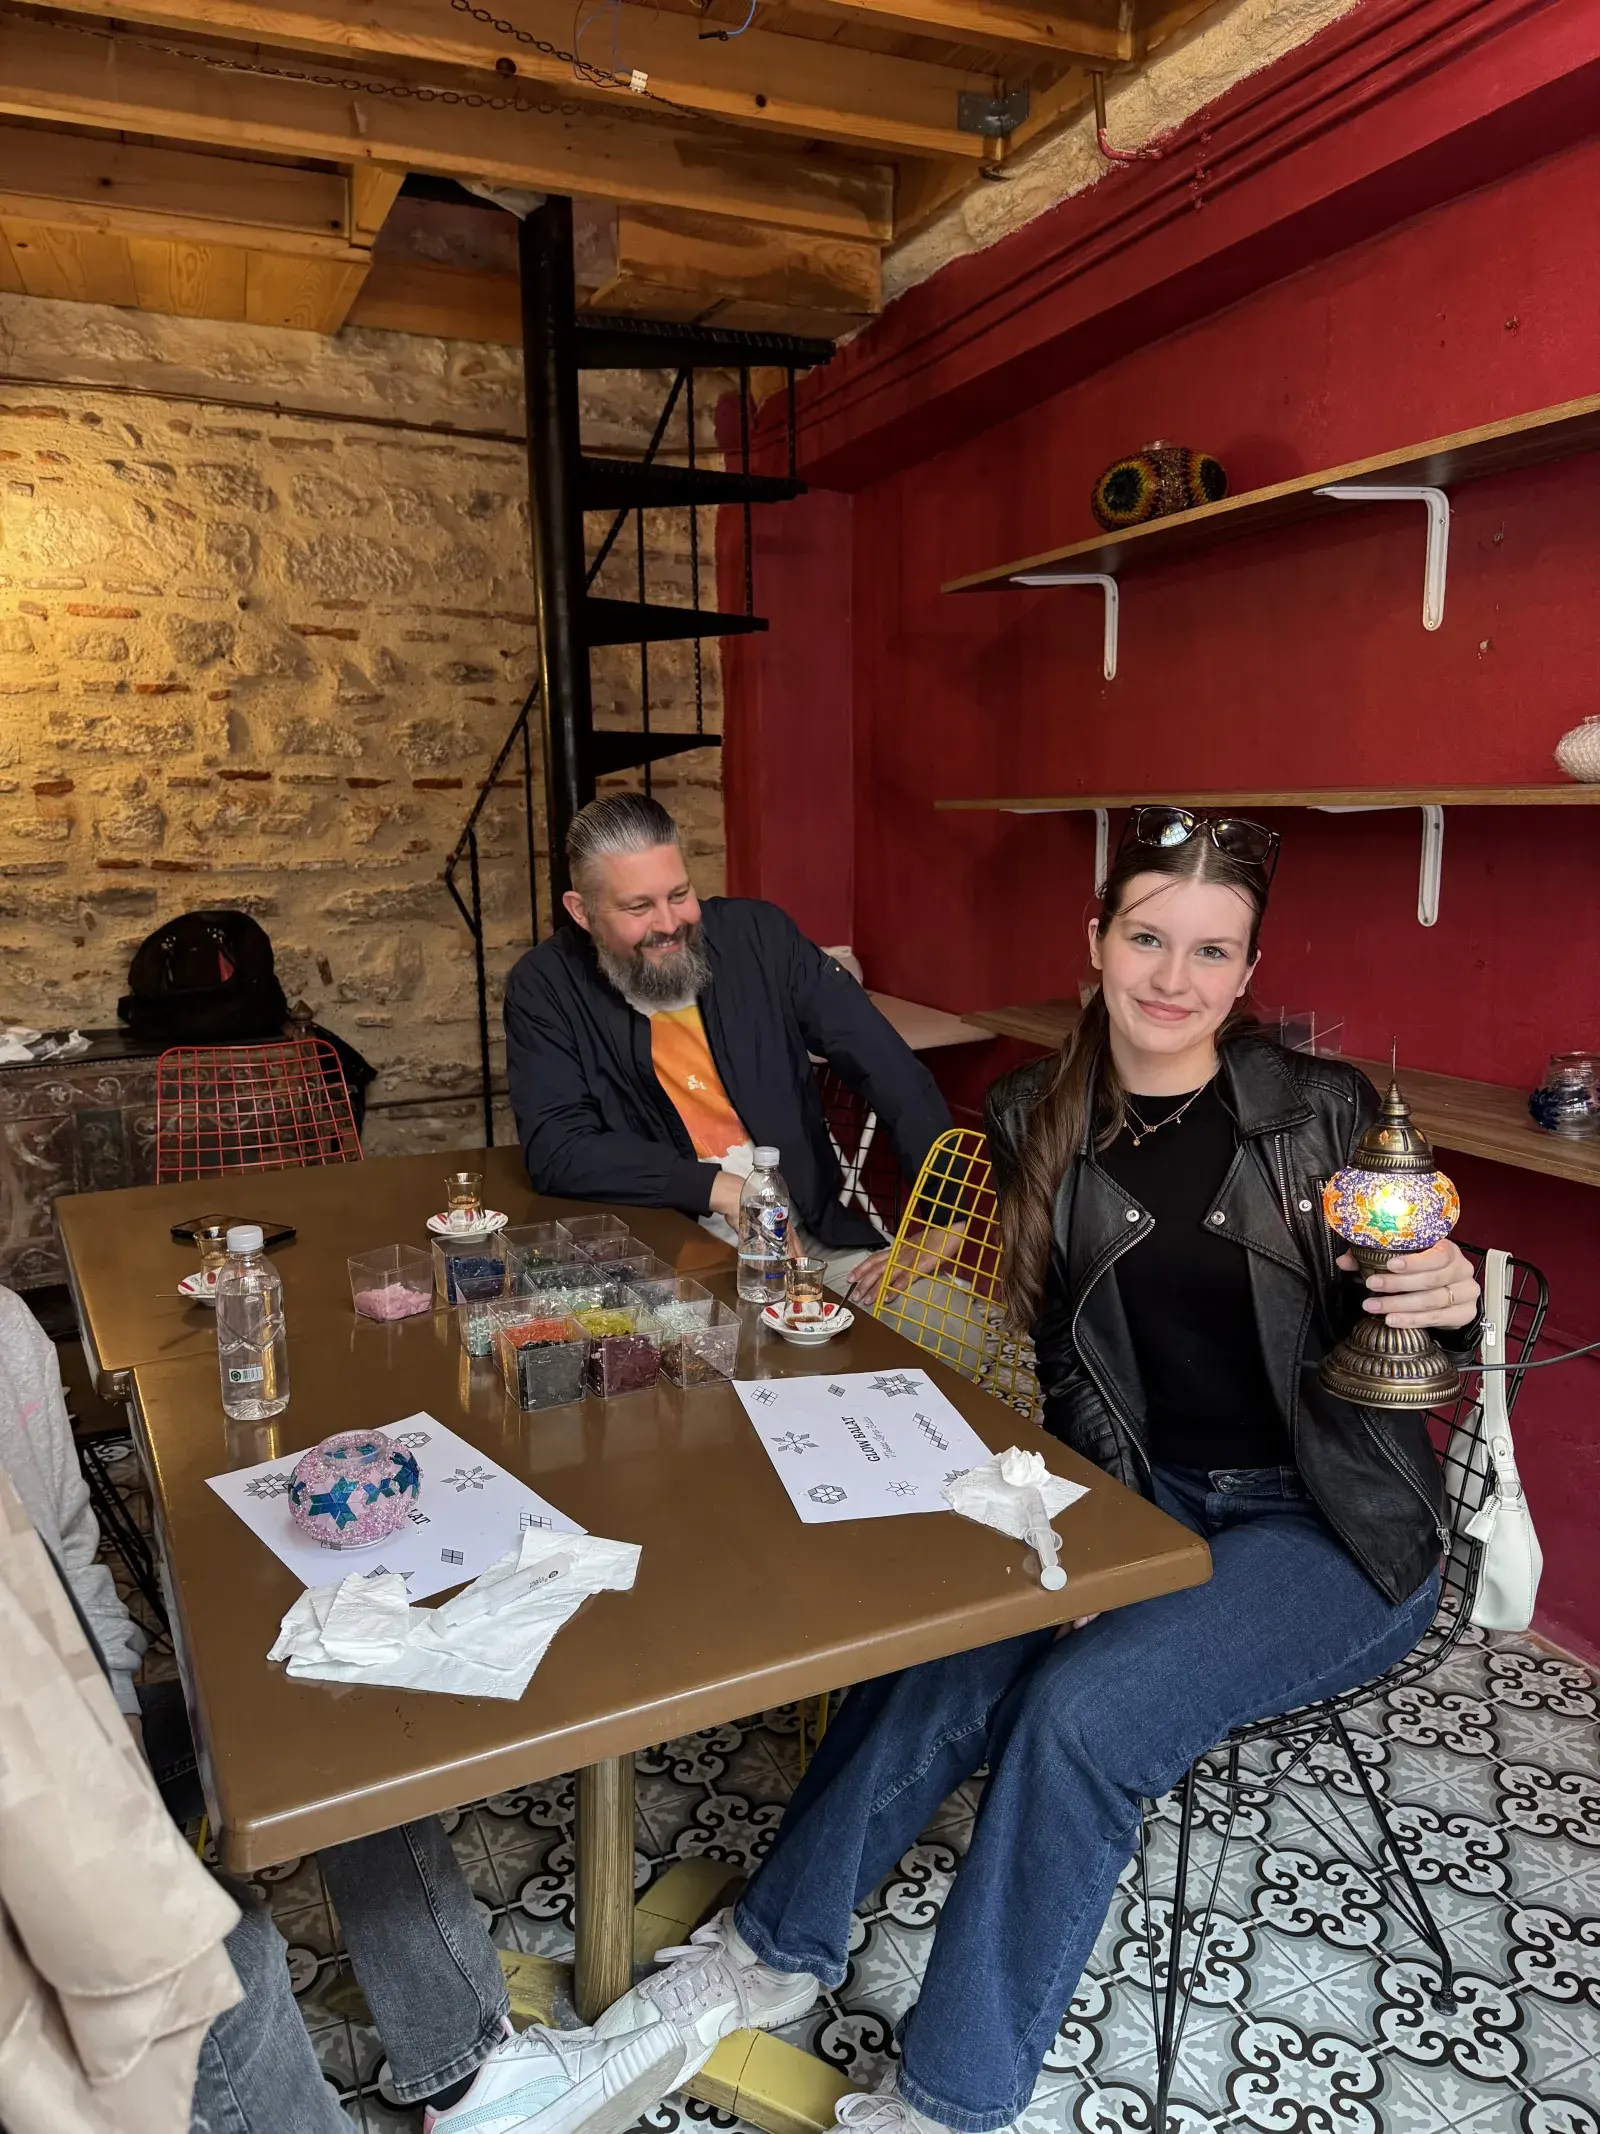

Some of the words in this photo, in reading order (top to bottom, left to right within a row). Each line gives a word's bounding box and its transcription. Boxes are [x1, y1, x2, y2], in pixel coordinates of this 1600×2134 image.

[841, 1416, 867, 1439] BALAT
[856, 1440, 881, 1462] GLOW
[407, 1508, 431, 1525] LAT
